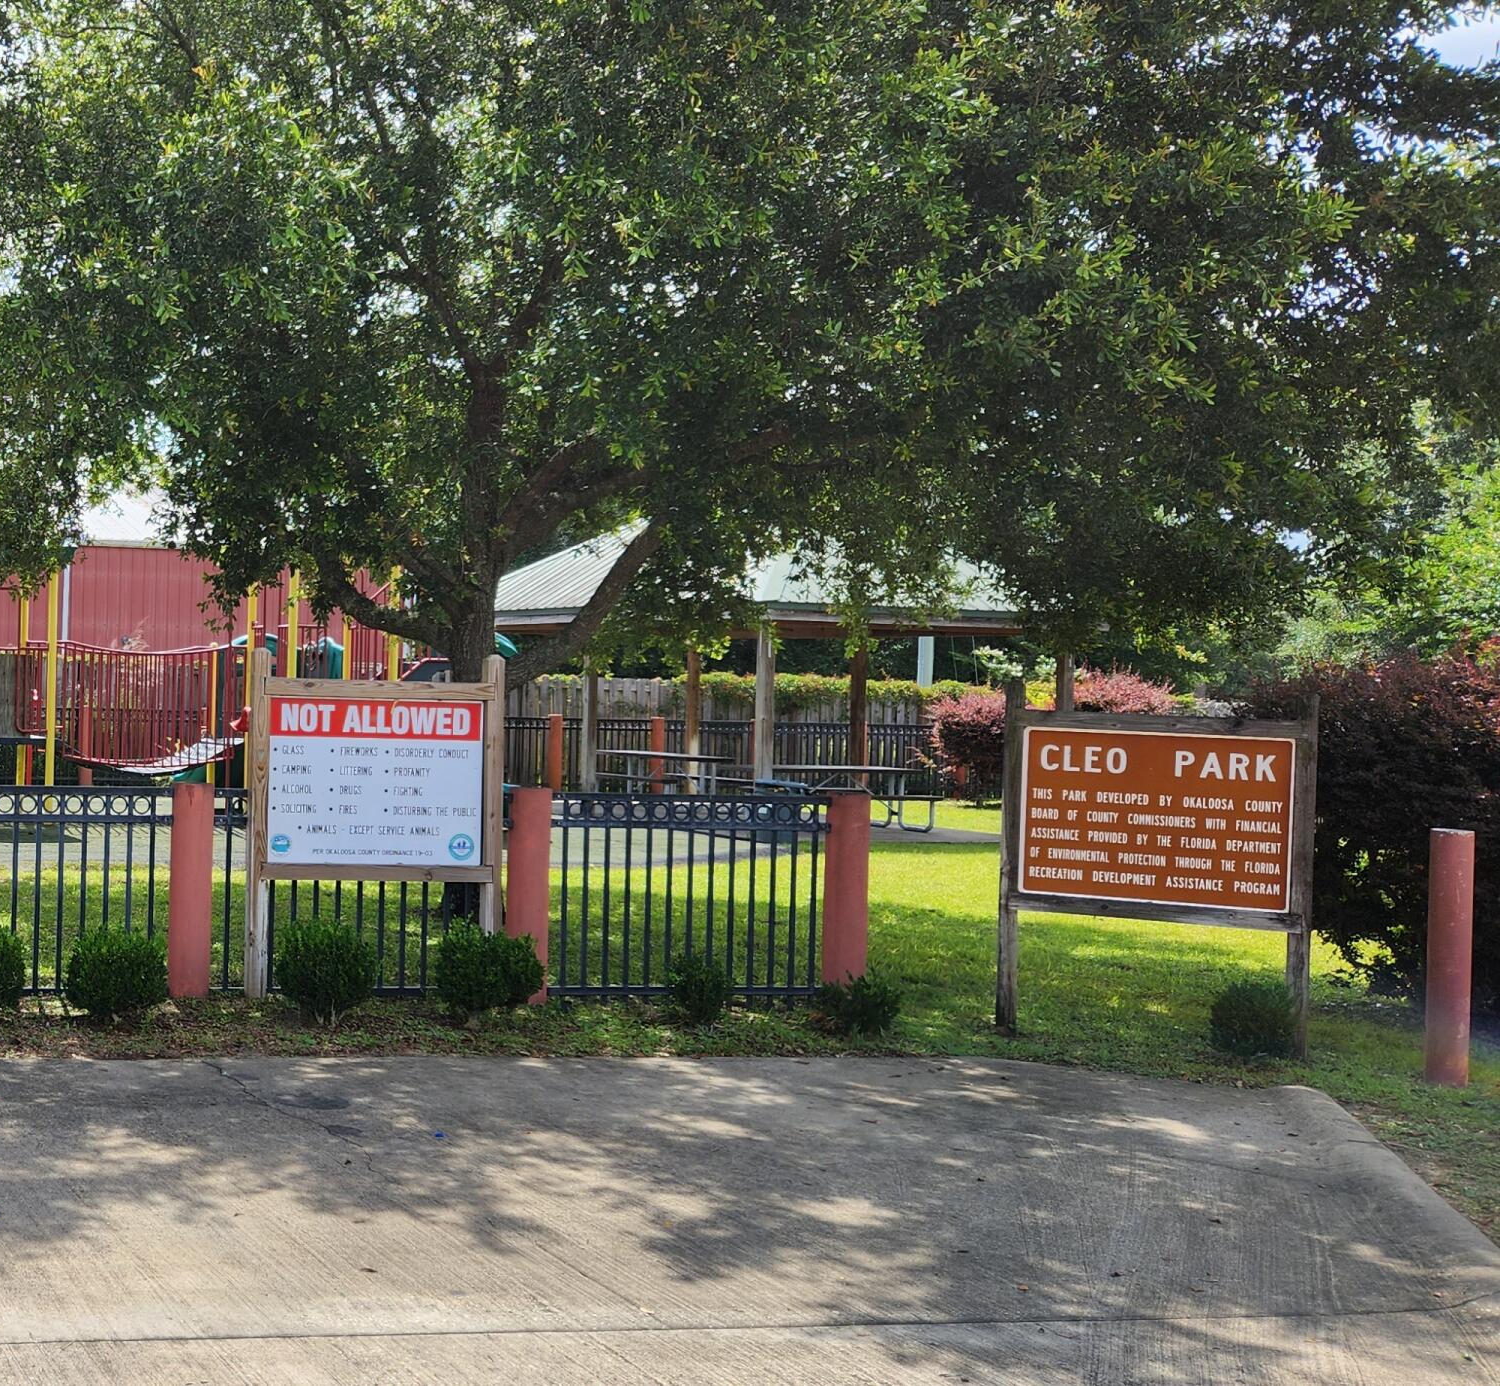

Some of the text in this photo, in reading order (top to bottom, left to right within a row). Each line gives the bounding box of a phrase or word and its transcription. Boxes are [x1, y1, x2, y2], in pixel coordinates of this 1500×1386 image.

[280, 703, 471, 735] NOT ALLOWED
[282, 745, 304, 755] GLASS
[340, 747, 378, 757] FIREWORKS
[394, 748, 469, 759] DISORDERLY CONDUCT
[1040, 744, 1277, 782] CLEO PARK
[282, 765, 312, 775] CAMPING
[340, 767, 373, 776] LITTERING
[394, 767, 431, 777] PROFANITY
[282, 784, 312, 794] ALCOHOL
[340, 785, 362, 795] DRUGS
[393, 786, 423, 796] FIGHTING
[1032, 788, 1283, 813] THIS PARK DEVELOPED BY OKALOOSA COUNTY
[281, 804, 317, 813] SOLICITING
[339, 805, 358, 814] FIRES
[392, 806, 477, 817] DISTURBING THE PUBLIC
[1031, 807, 1282, 834] BOARD OF COUNTY COMMISSIONERS WITH FINANCIAL
[306, 825, 337, 835] ANIMALS
[349, 825, 374, 836] EXCEPT
[378, 826, 405, 836] SERVICE
[410, 827, 440, 837] ANIMALS
[1031, 827, 1282, 855] ASSISTANCE PROVIDED BY THE FLORIDA DEPARTMENT
[1030, 847, 1281, 875] OF ENVIRONMENTAL PROTECTION THROUGH THE FLORIDA
[1029, 866, 1280, 896] RECREATION DEVELOPMENT ASSISTANCE PROGRAM
